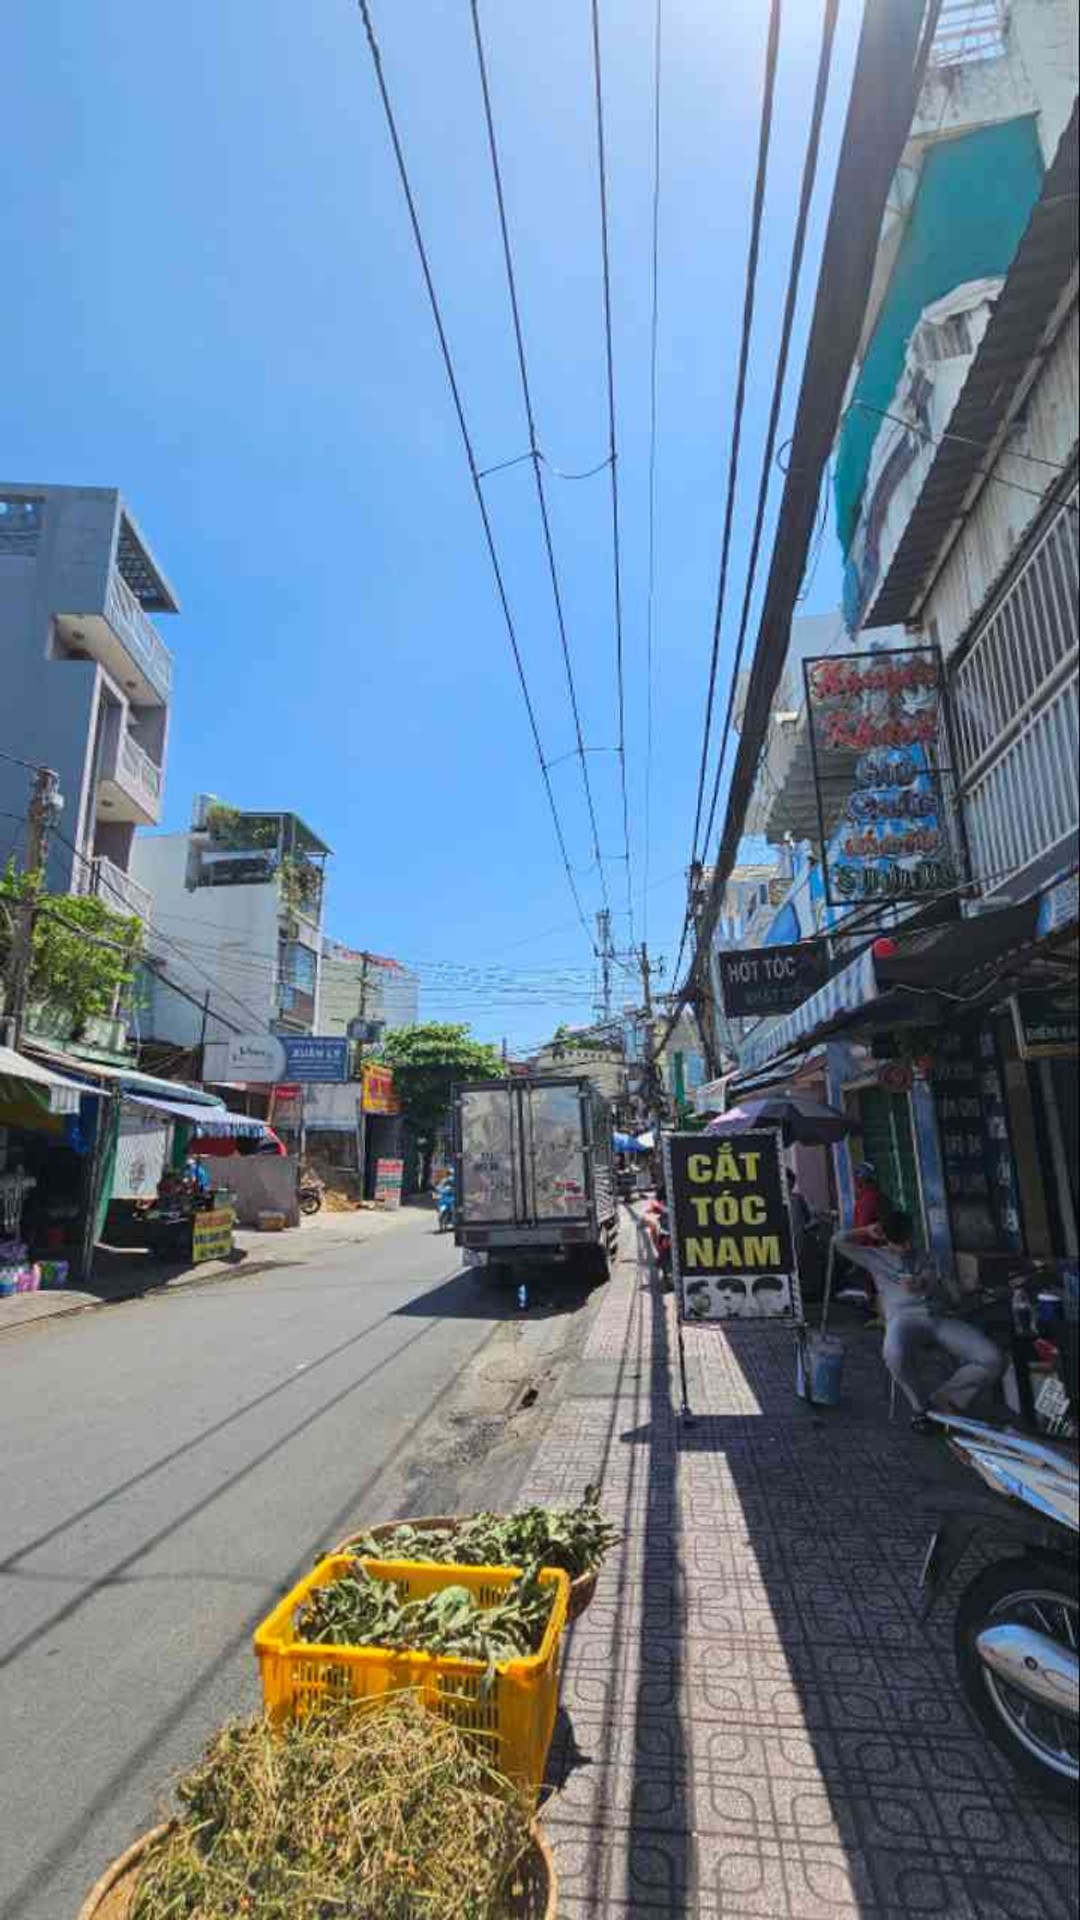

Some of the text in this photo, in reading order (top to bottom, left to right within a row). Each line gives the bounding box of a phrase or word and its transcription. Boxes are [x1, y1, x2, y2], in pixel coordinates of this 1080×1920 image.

[762, 954, 796, 980] TÓC
[687, 1142, 760, 1183] CẮT
[690, 1190, 768, 1226] TÓC
[685, 1236, 782, 1268] NAM
